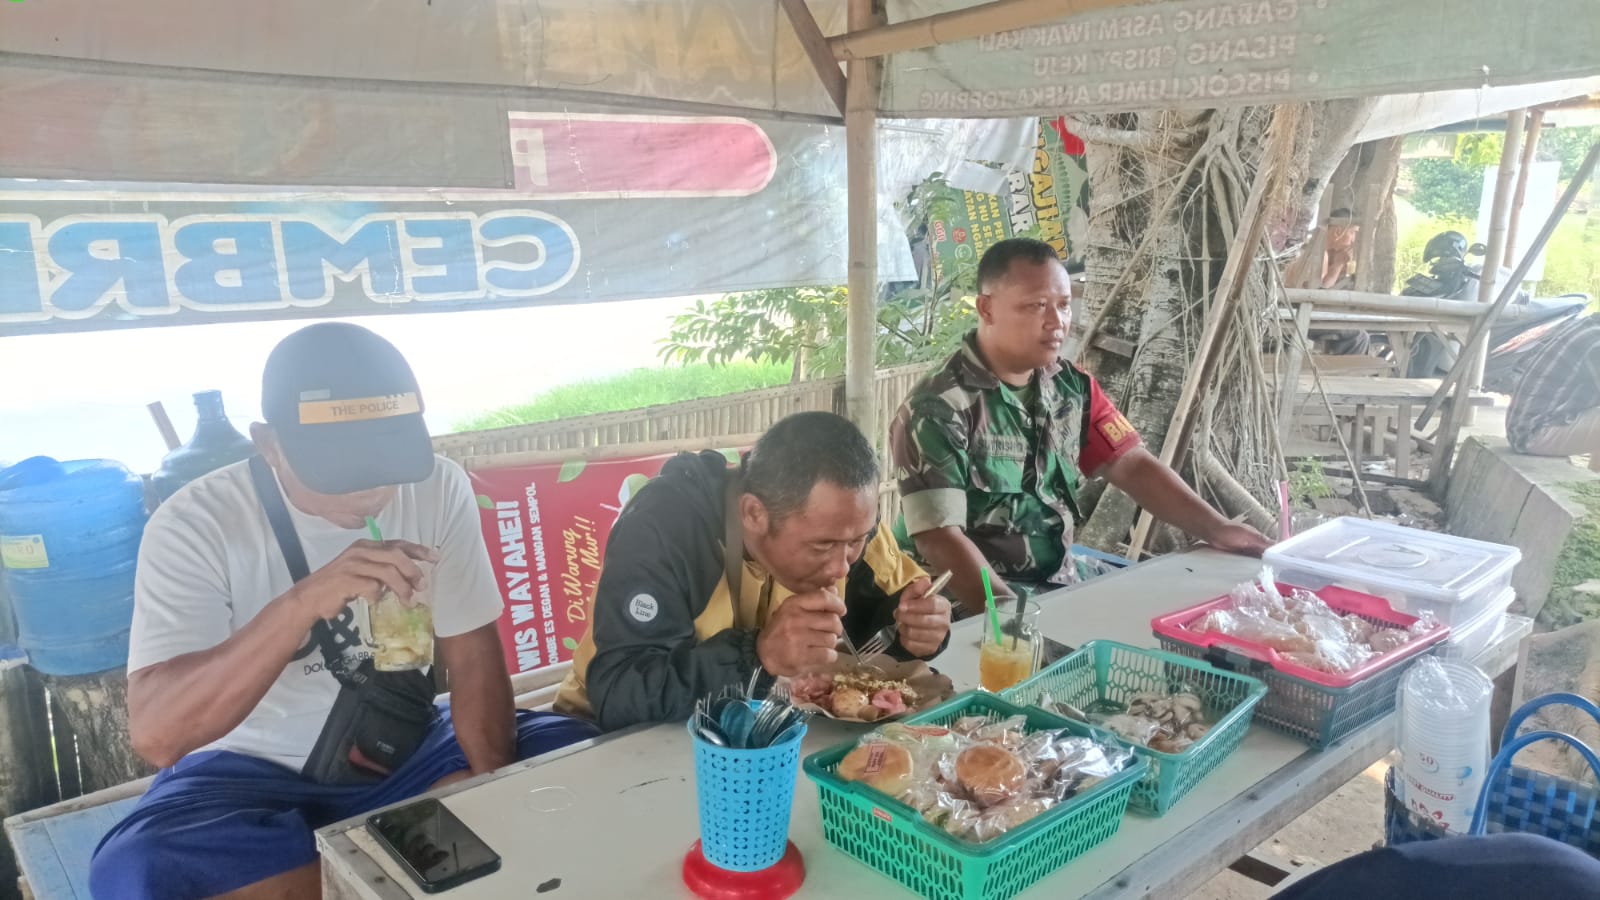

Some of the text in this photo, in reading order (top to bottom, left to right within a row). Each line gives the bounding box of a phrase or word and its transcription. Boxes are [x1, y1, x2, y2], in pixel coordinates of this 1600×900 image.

[331, 400, 400, 417] THE POLICE
[525, 482, 541, 524] SEMPOL
[531, 526, 547, 571] MANGAN
[538, 573, 548, 582] &
[560, 527, 586, 623] Di Warung
[538, 583, 552, 619] DEGAN
[544, 619, 555, 634] ES
[514, 627, 541, 672] WIS
